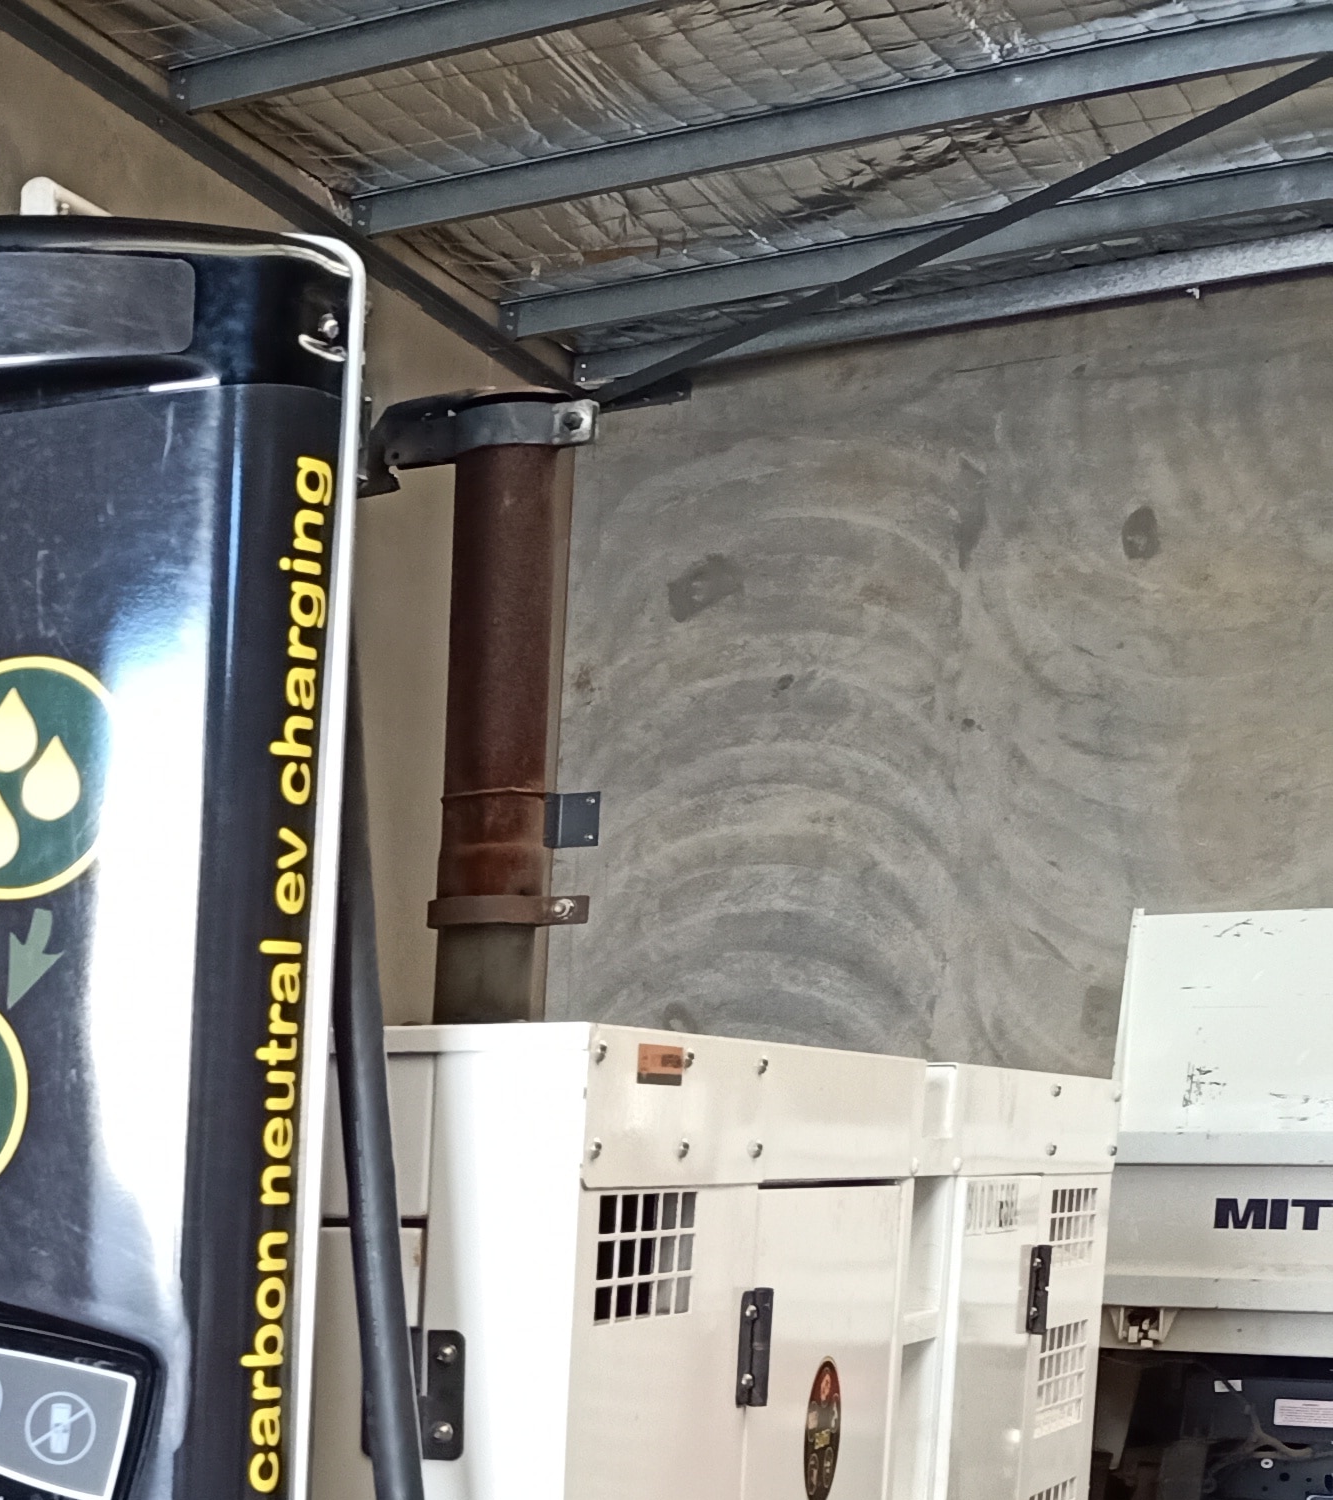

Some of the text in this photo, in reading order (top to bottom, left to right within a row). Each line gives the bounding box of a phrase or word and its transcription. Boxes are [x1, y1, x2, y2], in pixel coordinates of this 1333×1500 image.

[240, 456, 332, 1493] carbon neutral ev charging
[1214, 1198, 1333, 1230] MIT
